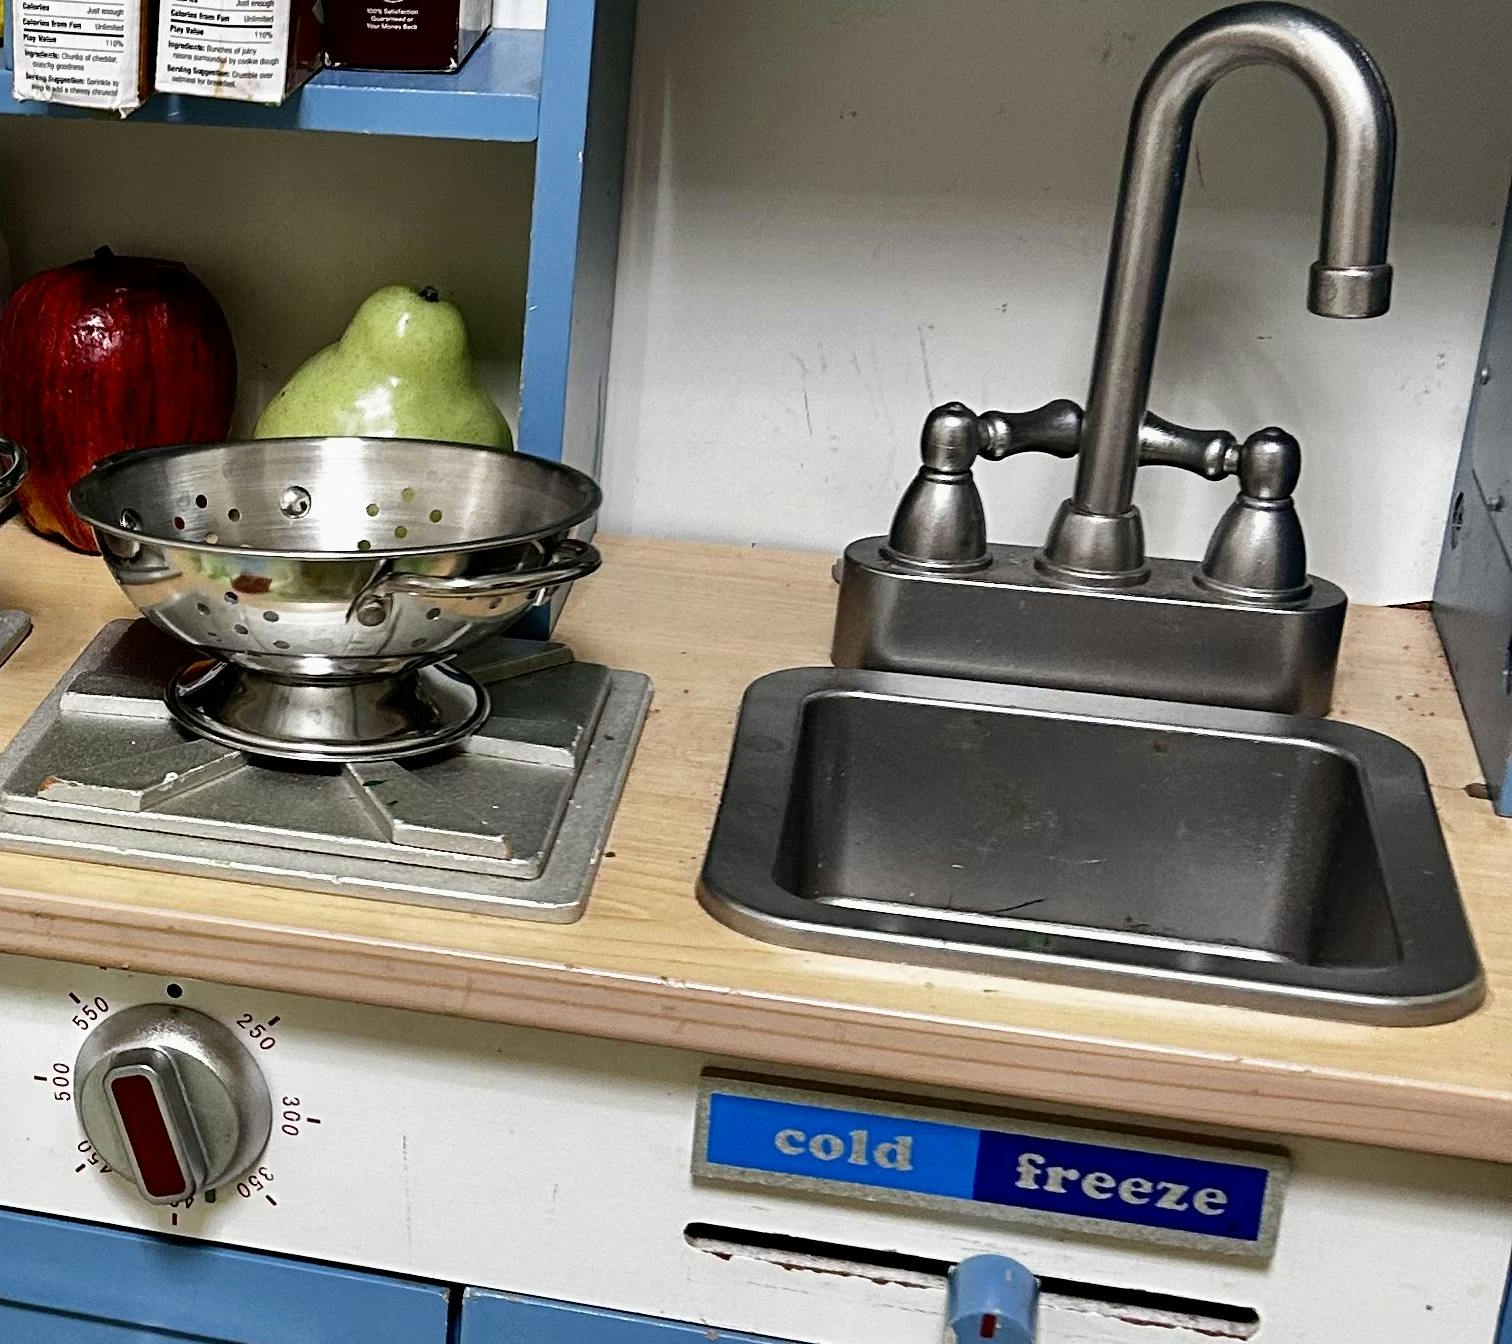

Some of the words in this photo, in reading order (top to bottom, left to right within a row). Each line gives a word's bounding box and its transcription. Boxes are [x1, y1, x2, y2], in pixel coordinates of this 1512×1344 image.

[23, 2, 49, 11] Calories
[23, 18, 49, 27] Calories
[171, 9, 197, 18] Calories
[217, 14, 229, 22] Fun
[72, 996, 109, 1031] 550
[236, 1013, 276, 1050] 250
[53, 1063, 71, 1102] 500
[282, 1096, 301, 1136] 300
[237, 1166, 274, 1198] 350
[774, 1128, 913, 1172] cold
[1015, 1153, 1228, 1217] freeze
